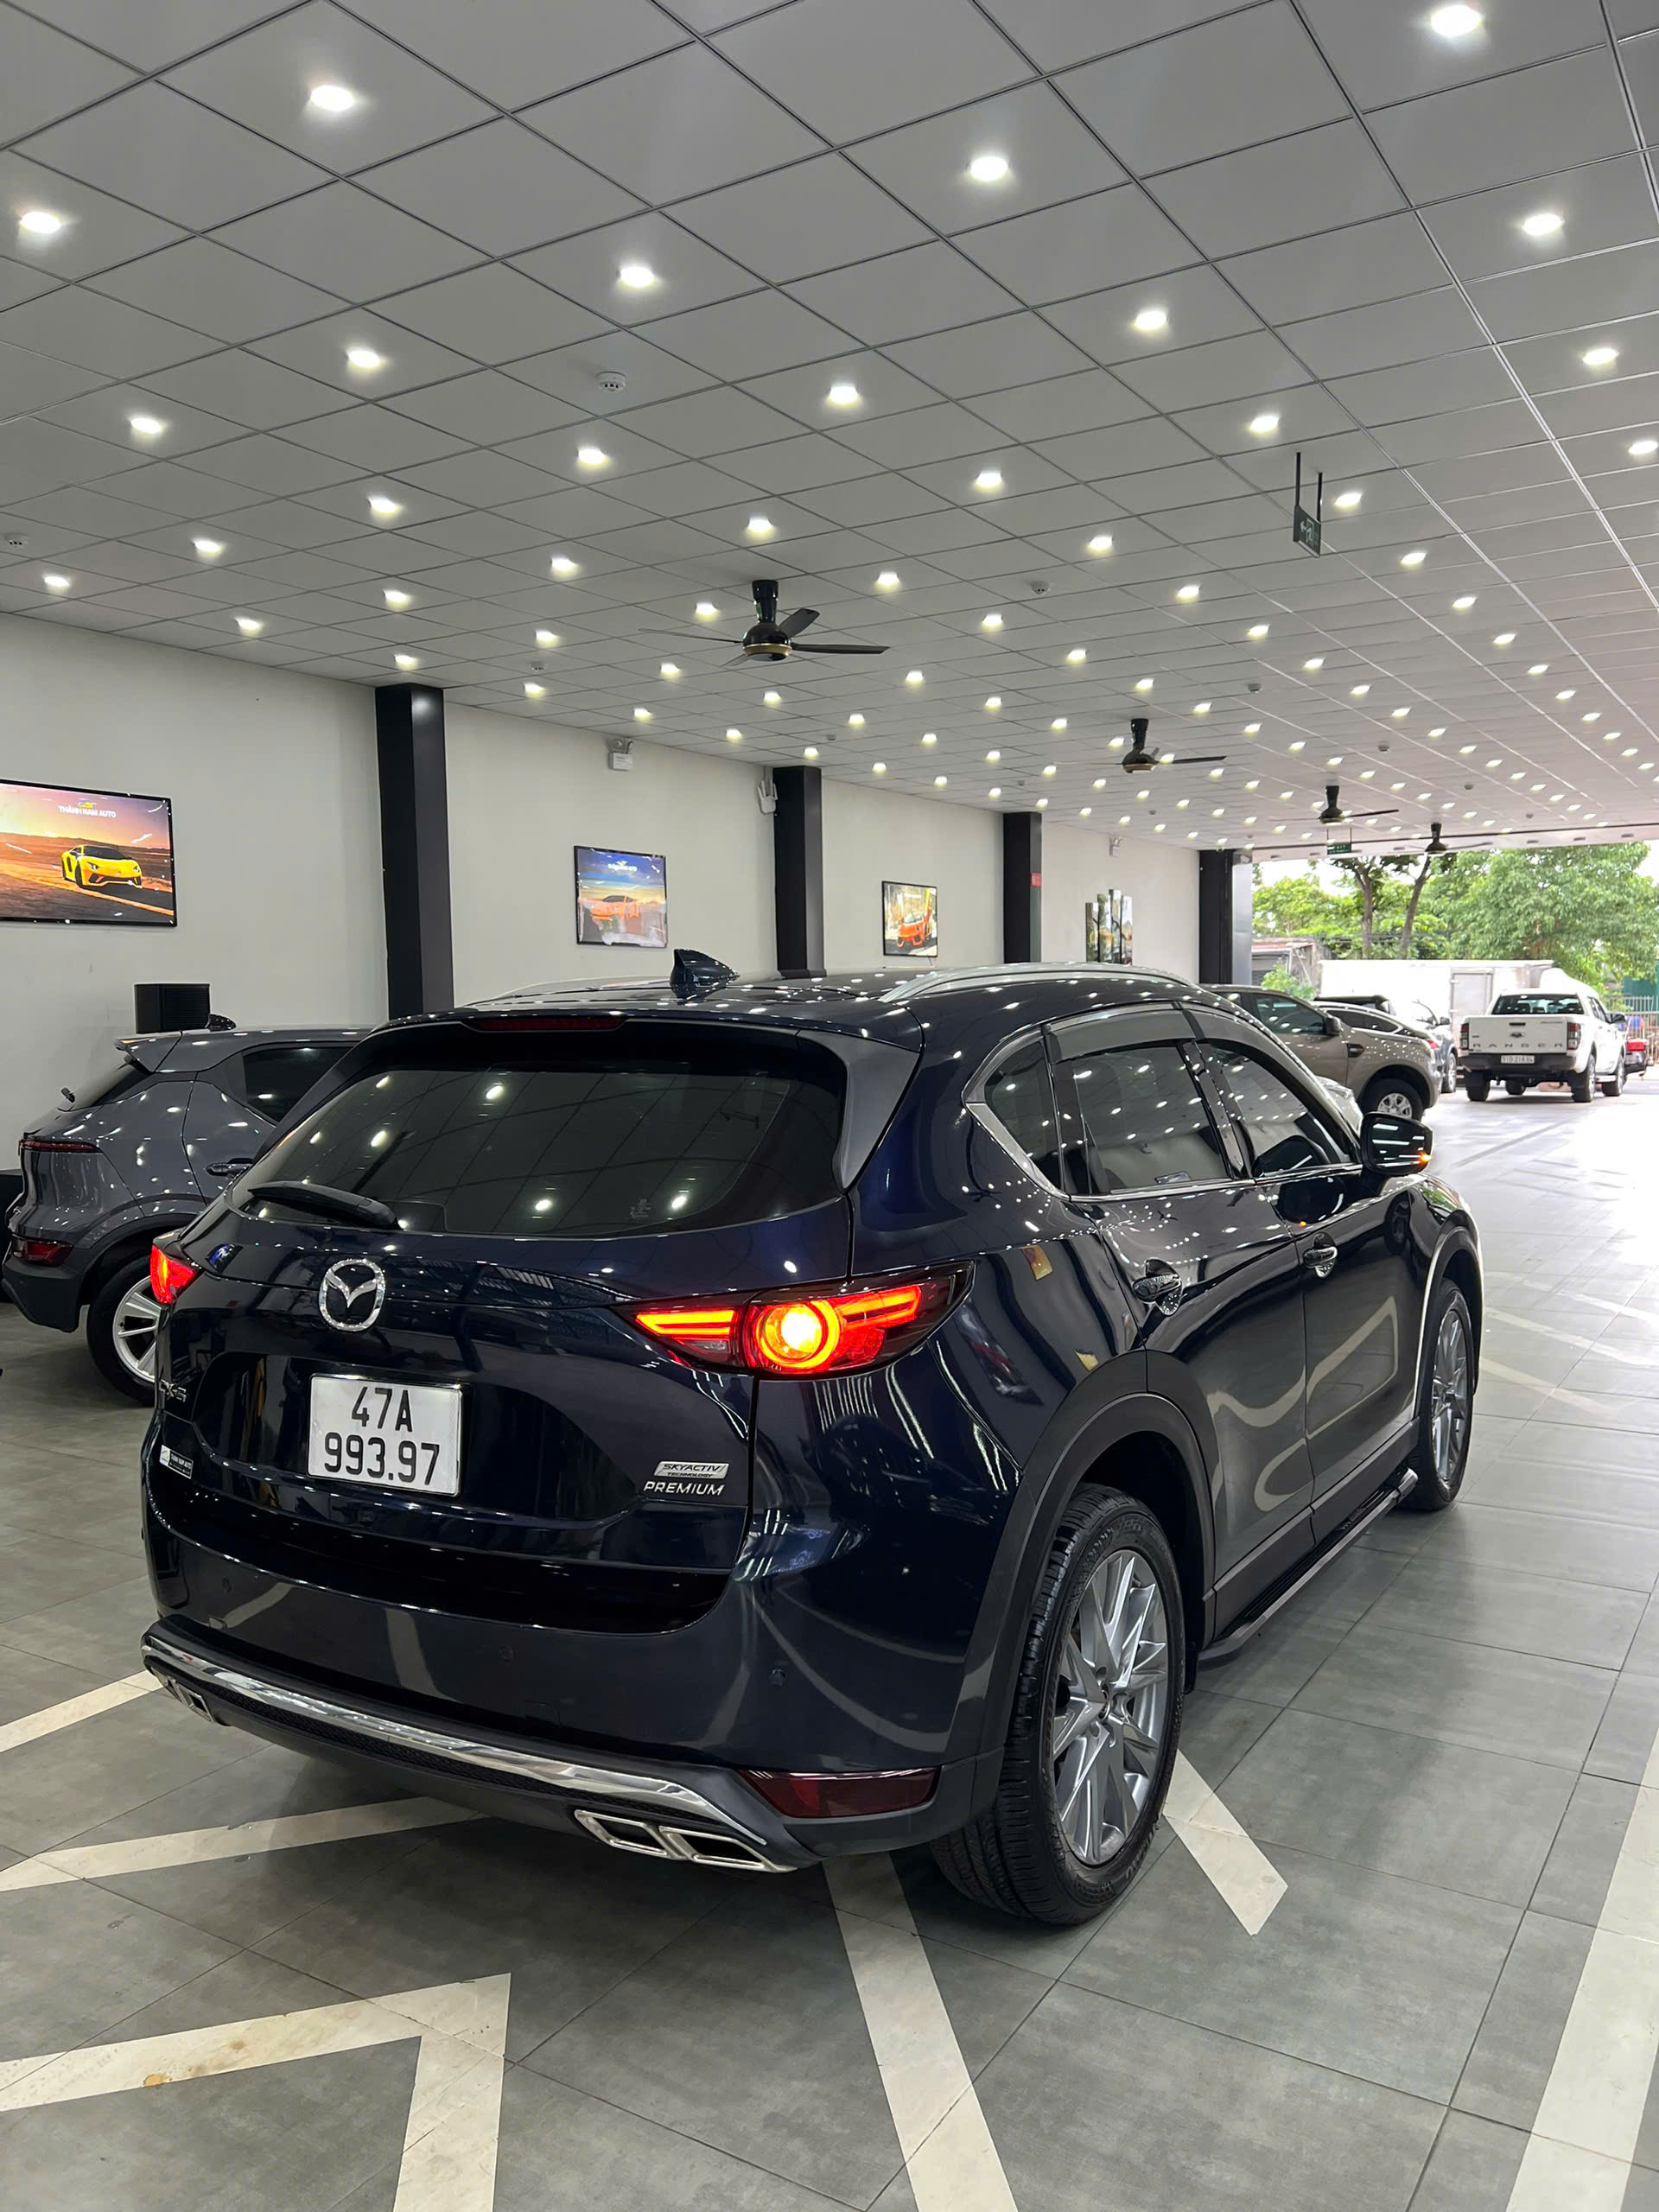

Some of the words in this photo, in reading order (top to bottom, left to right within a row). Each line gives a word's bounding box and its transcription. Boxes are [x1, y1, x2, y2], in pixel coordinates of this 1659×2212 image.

[351, 1386, 413, 1433] 47A
[324, 1432, 440, 1485] 993.97
[663, 1463, 721, 1471] SKYACTIV
[643, 1480, 725, 1496] PREMIUM
